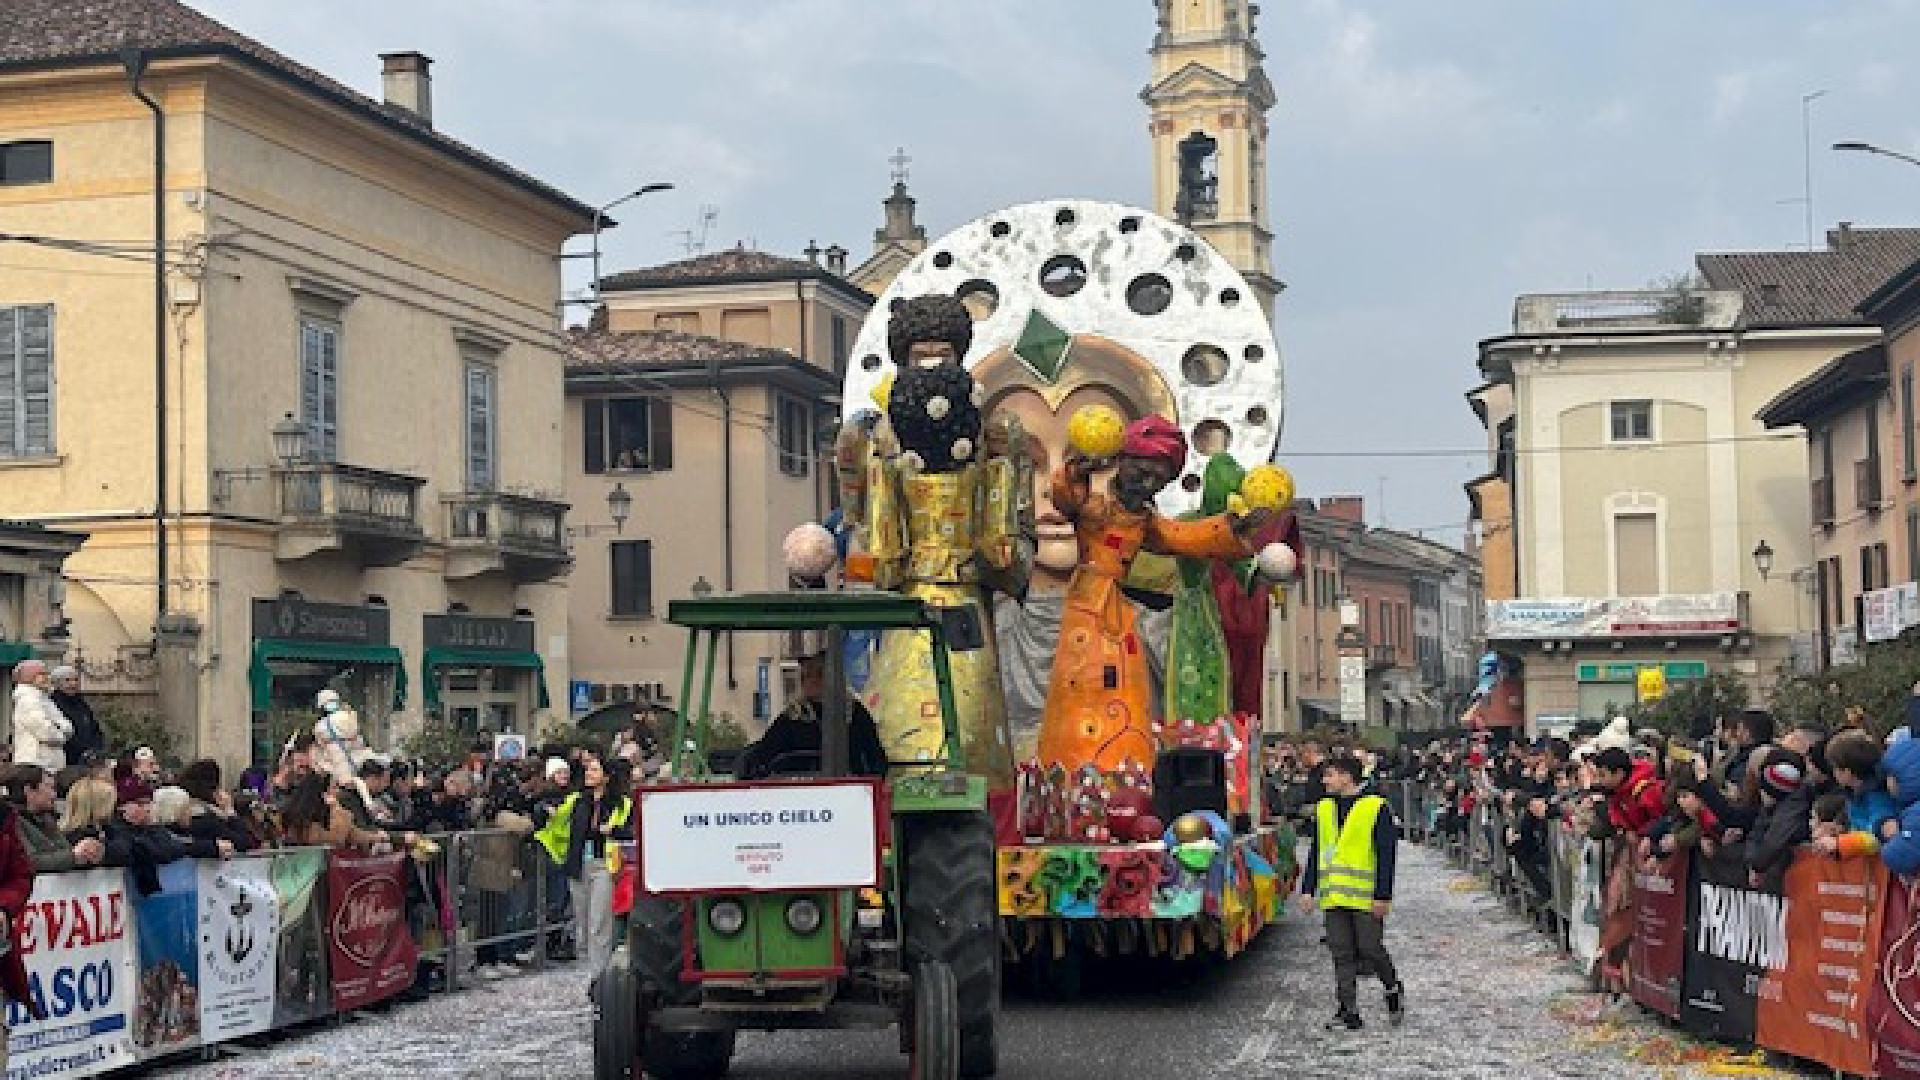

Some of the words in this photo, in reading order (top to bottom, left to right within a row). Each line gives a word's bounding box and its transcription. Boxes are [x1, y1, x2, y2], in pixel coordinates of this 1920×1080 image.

[683, 814, 709, 828] UN
[716, 811, 774, 826] UNICO
[780, 809, 834, 824] CIELO
[1697, 881, 1790, 972] PHANTOM
